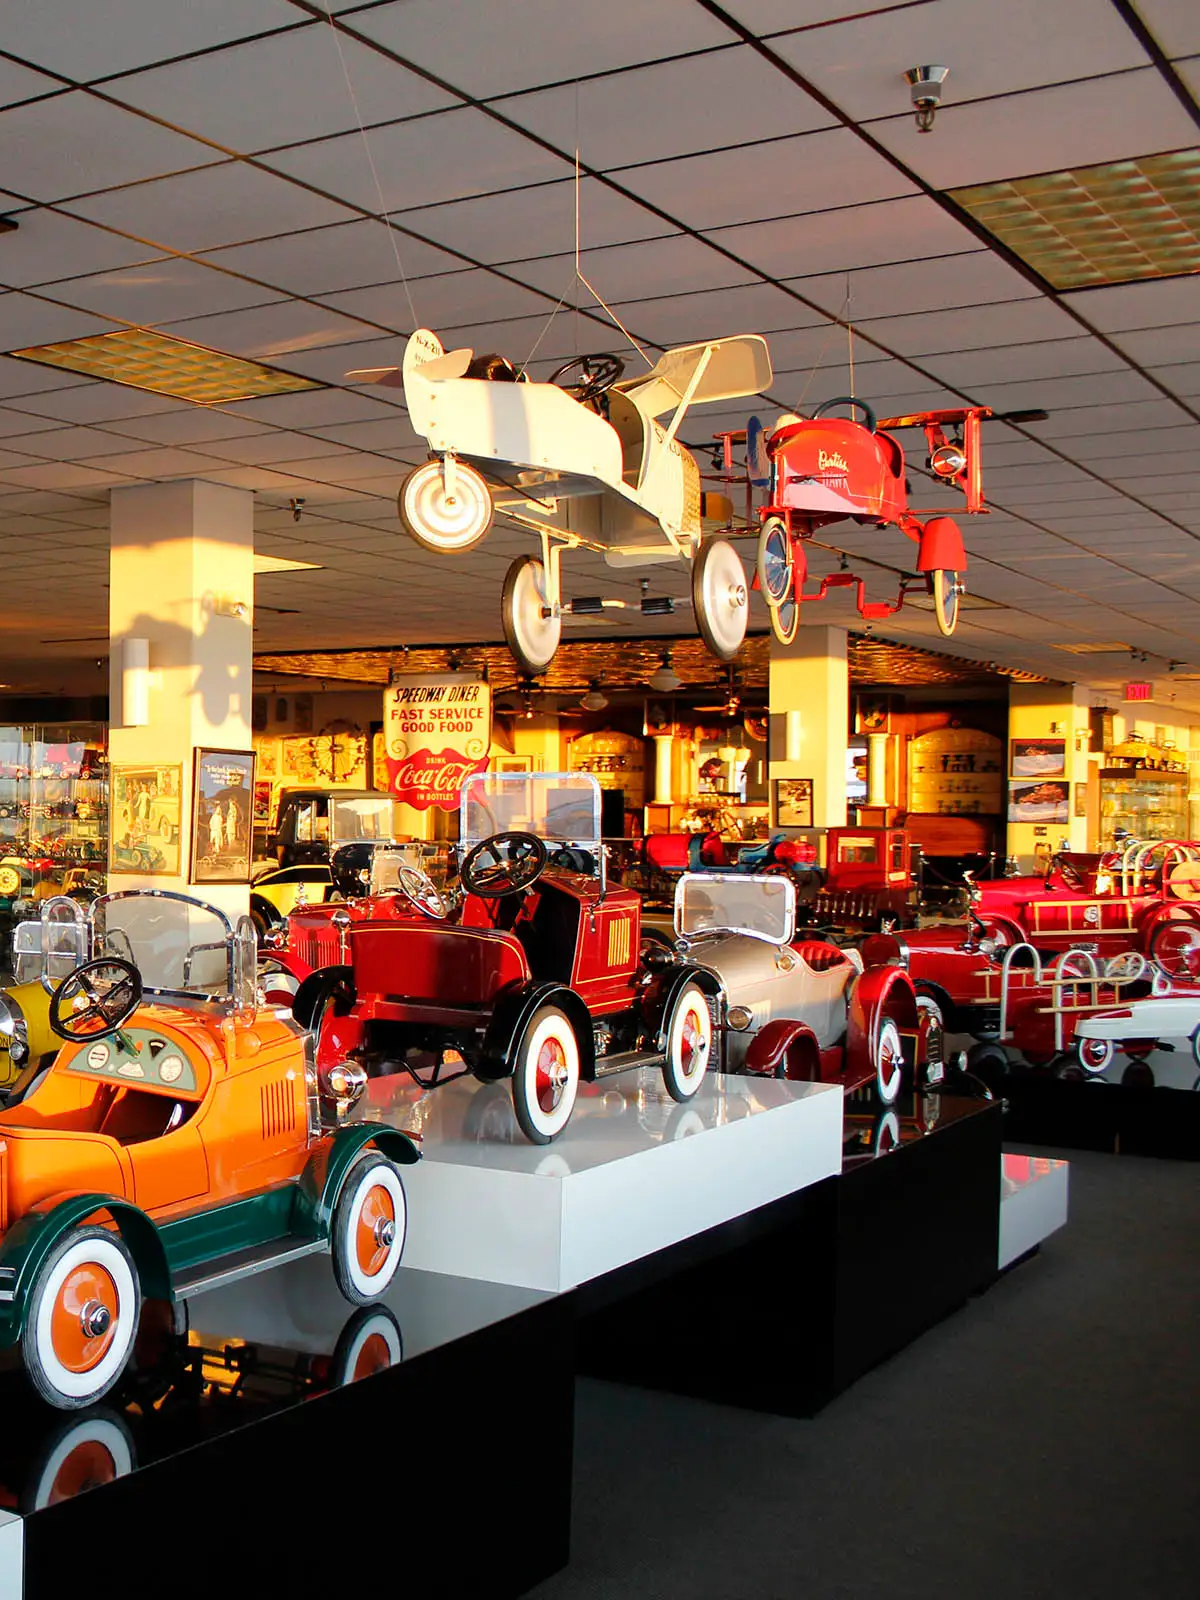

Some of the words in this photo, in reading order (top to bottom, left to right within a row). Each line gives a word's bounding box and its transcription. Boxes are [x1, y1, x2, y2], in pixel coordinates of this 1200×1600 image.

[393, 687, 447, 703] SPEEDWAY
[448, 685, 480, 702] DINER
[391, 709, 424, 720] FAST
[429, 708, 484, 719] SERVICE
[401, 722, 435, 733] GOOD
[439, 721, 473, 732] FOOD
[426, 793, 454, 801] BOTTLES
